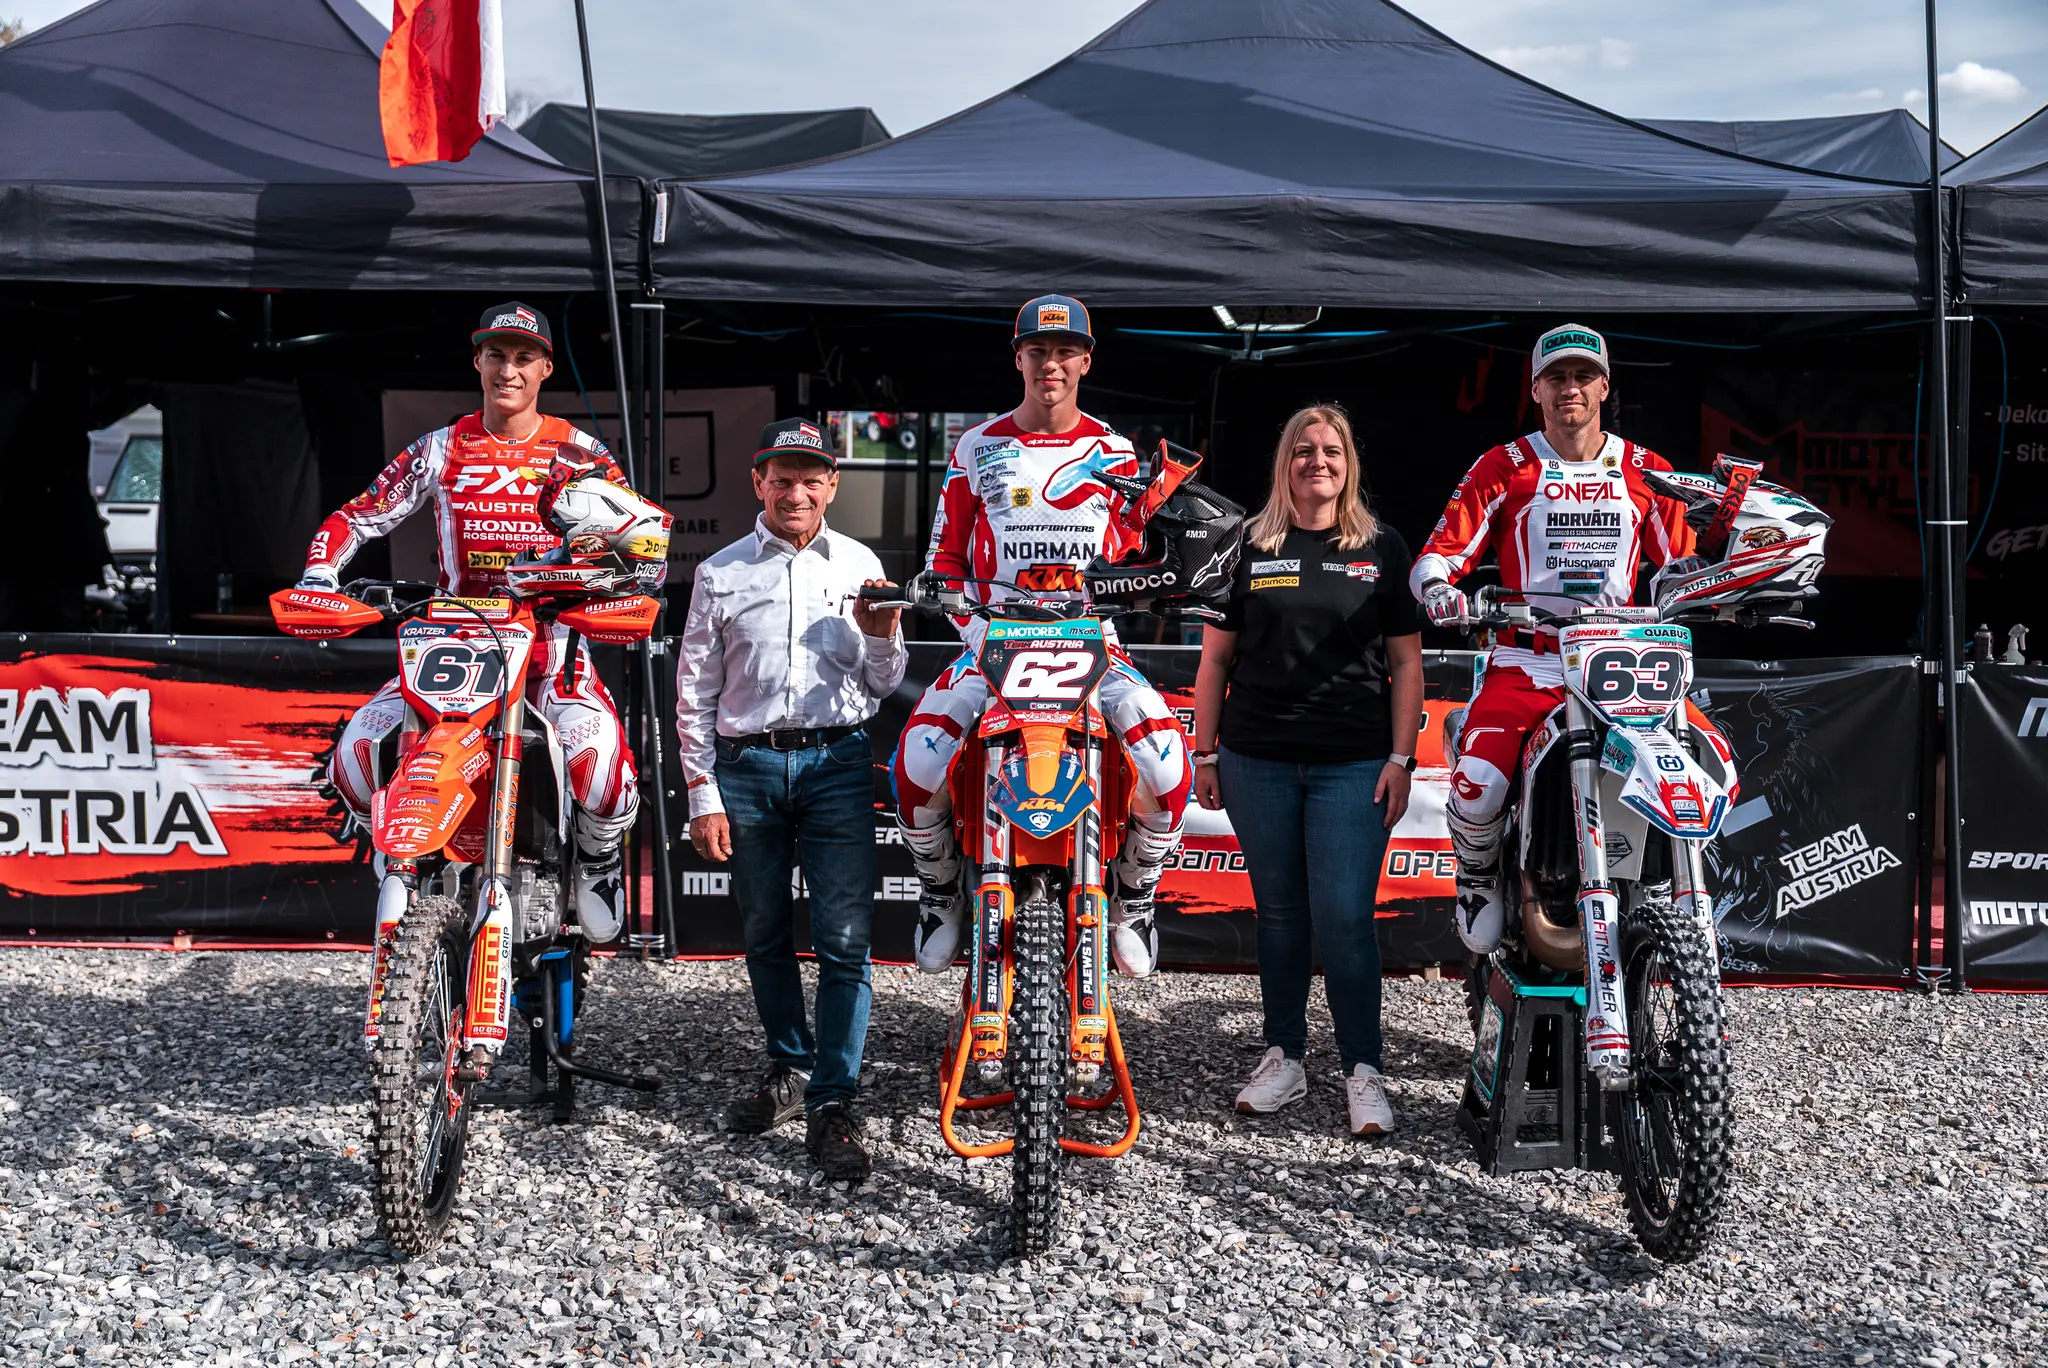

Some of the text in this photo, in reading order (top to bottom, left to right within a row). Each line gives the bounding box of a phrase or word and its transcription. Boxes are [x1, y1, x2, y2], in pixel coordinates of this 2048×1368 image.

[1042, 313, 1065, 322] KTM
[1545, 333, 1598, 350] QUABUS
[1026, 438, 1071, 446] alpinestars
[495, 449, 526, 459] LTE
[1114, 478, 1147, 491] DIMOCO
[1666, 474, 1718, 491] AIROH
[463, 502, 538, 514] AUSTR
[1547, 509, 1621, 527] HORVÁTH
[1004, 525, 1095, 533] SPORTFIGHTERS
[463, 532, 555, 542] ROSENBERGER
[505, 542, 555, 550] MOTORS
[1003, 541, 1096, 561] NORMAN
[1561, 541, 1618, 550] FITMACHER
[1322, 562, 1380, 576] TEAM AUSTRIA
[1558, 557, 1616, 569] Husqvarna
[536, 571, 583, 581] AUSTRIA
[1014, 563, 1085, 592] KTM
[1261, 578, 1298, 587] DIMOCO
[1094, 571, 1177, 596] DIMOCO
[1683, 571, 1738, 595] AUSTRIA
[403, 626, 446, 637] KRATZER
[590, 632, 635, 640] HONDA
[1007, 627, 1063, 637] MOTOREX
[1566, 629, 1619, 639] SANDNER
[1644, 629, 1689, 640] QUABUS
[416, 646, 508, 694] 61
[1000, 651, 1095, 699] 62
[1587, 650, 1685, 702] 63
[1605, 742, 1628, 766] QUABUS
[1016, 797, 1065, 813] KTM
[388, 817, 422, 826] ZORN
[385, 825, 433, 841] LTE
[1782, 827, 1866, 873] TEAM
[1779, 848, 1898, 914] AUSTRIA
[987, 907, 999, 1004] PLEW TYRES
[1082, 948, 1092, 995] PLEWS
[1593, 921, 1617, 1013] FITMAHER
[473, 924, 502, 1025] PIRELLI
[974, 1030, 1001, 1042] KTM
[1081, 1033, 1106, 1045] KTM
